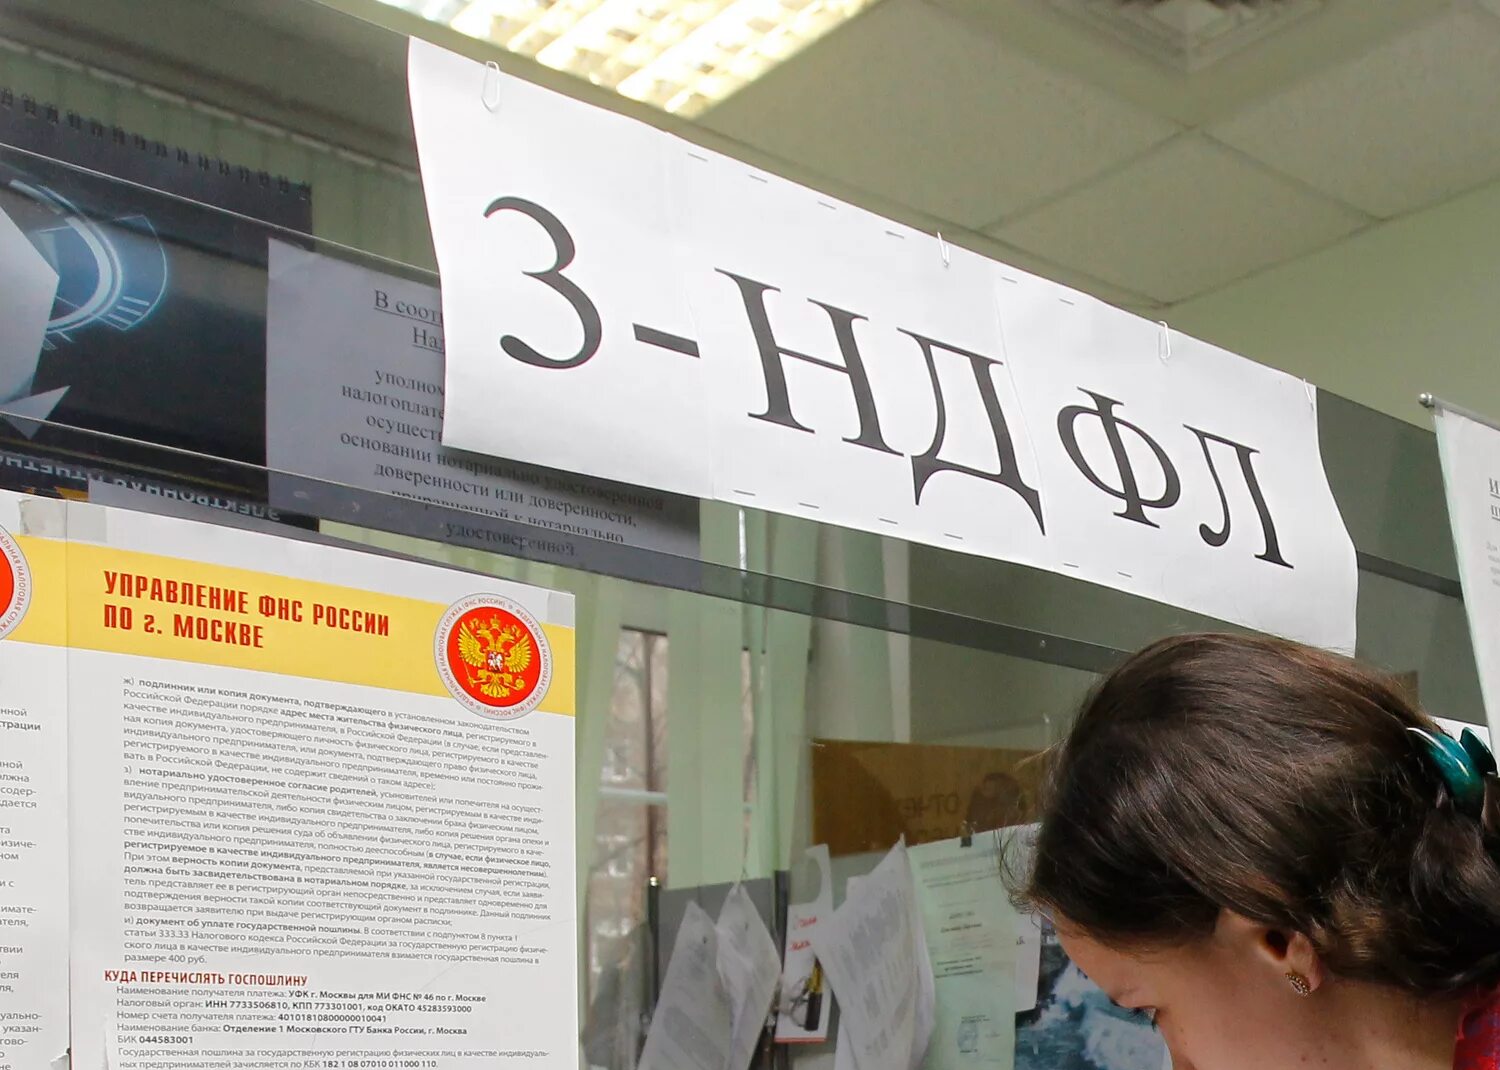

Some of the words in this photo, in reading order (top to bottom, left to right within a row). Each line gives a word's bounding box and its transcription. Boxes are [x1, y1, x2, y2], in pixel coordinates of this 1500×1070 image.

[374, 289, 390, 309] В
[483, 195, 1293, 569] 3-НДФЛ
[340, 432, 431, 463] основании
[374, 463, 489, 497] доверенности
[495, 487, 524, 504] или
[528, 492, 637, 529] доверенности,
[104, 571, 249, 614] УПРАВЛЕНИЕ
[258, 595, 303, 623] ФНС
[312, 603, 389, 636] РОССИИ
[104, 604, 132, 630] ПО
[144, 615, 163, 634] г.
[173, 614, 264, 648] МОСКВЕ
[139, 680, 195, 691] подлинник
[218, 689, 247, 697] копия
[249, 693, 301, 705] документа,
[304, 700, 386, 716] подтверждающего
[394, 712, 455, 724] установленном
[457, 720, 529, 734] законодательством
[105, 970, 136, 983] КУДА
[141, 971, 224, 983] ПЕРЕЧИСЛЯТЬ
[228, 974, 306, 985] ГОСПОШЛИНУ
[116, 986, 189, 995] Наименование
[116, 998, 170, 1006] Налоговый
[116, 1011, 149, 1020] Номер
[117, 1023, 189, 1031] Наименование
[223, 1024, 276, 1032] Отделение
[118, 1047, 198, 1057] Государственная
[392, 1049, 439, 1057] физических
[139, 1060, 230, 1069] предпринимателей
